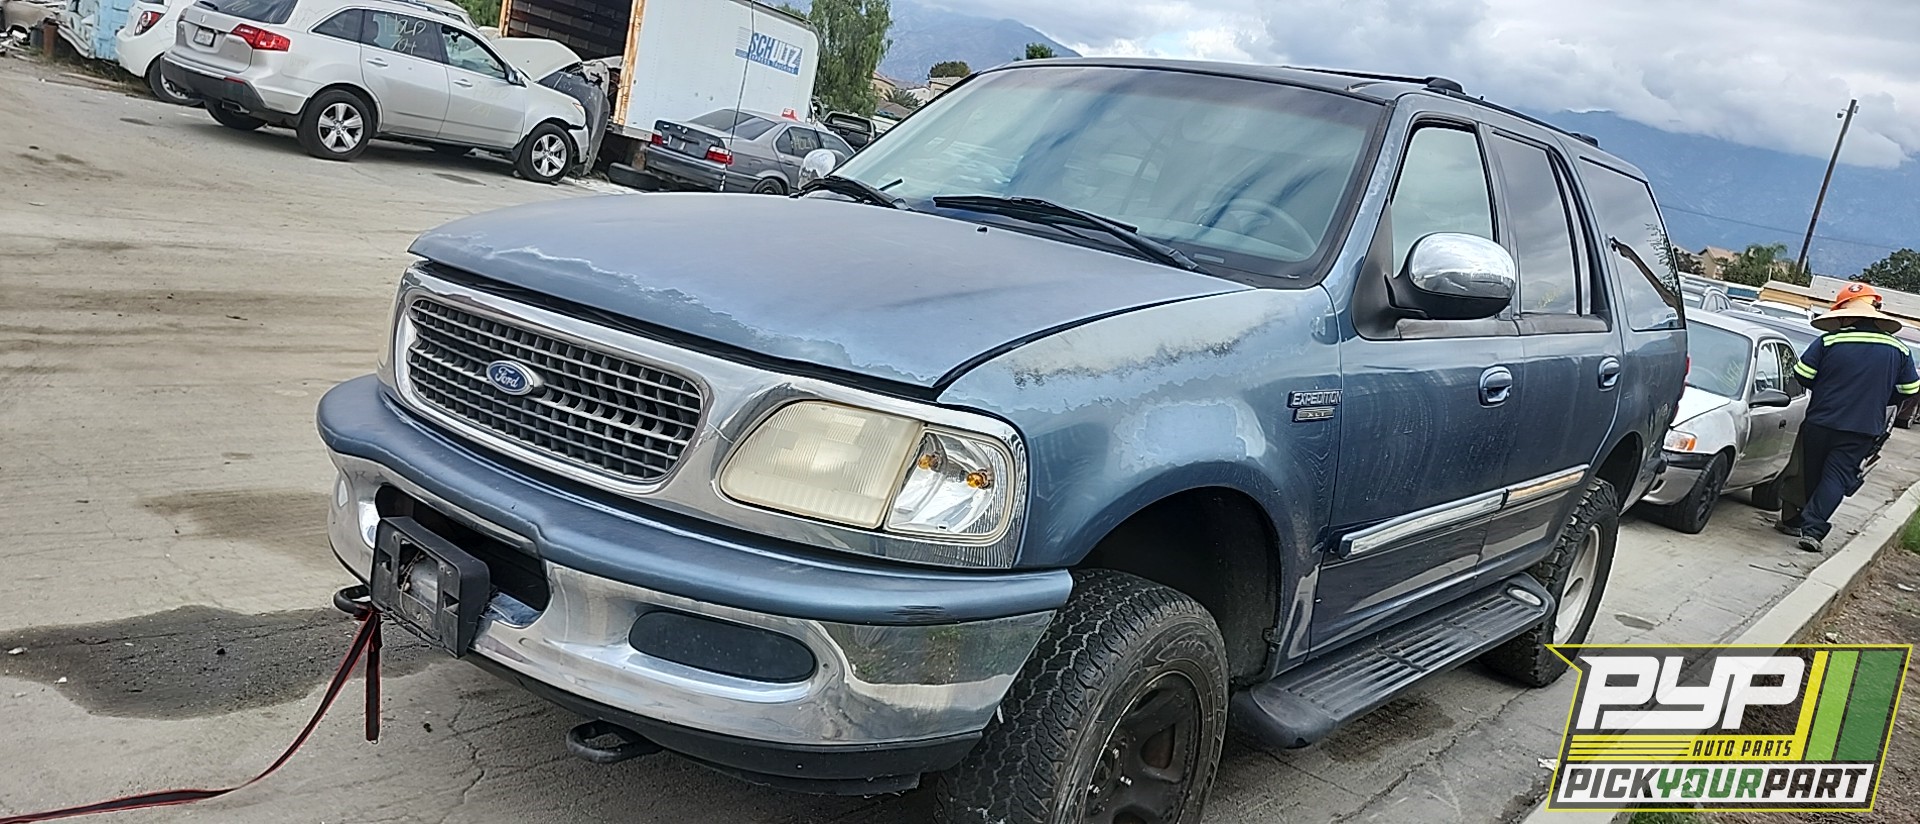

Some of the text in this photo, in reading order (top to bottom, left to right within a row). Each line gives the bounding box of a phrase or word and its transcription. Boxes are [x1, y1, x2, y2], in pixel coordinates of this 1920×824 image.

[751, 32, 802, 68] SCHULTZ
[494, 366, 521, 388] Ford
[1293, 391, 1341, 405] EXPEDITION
